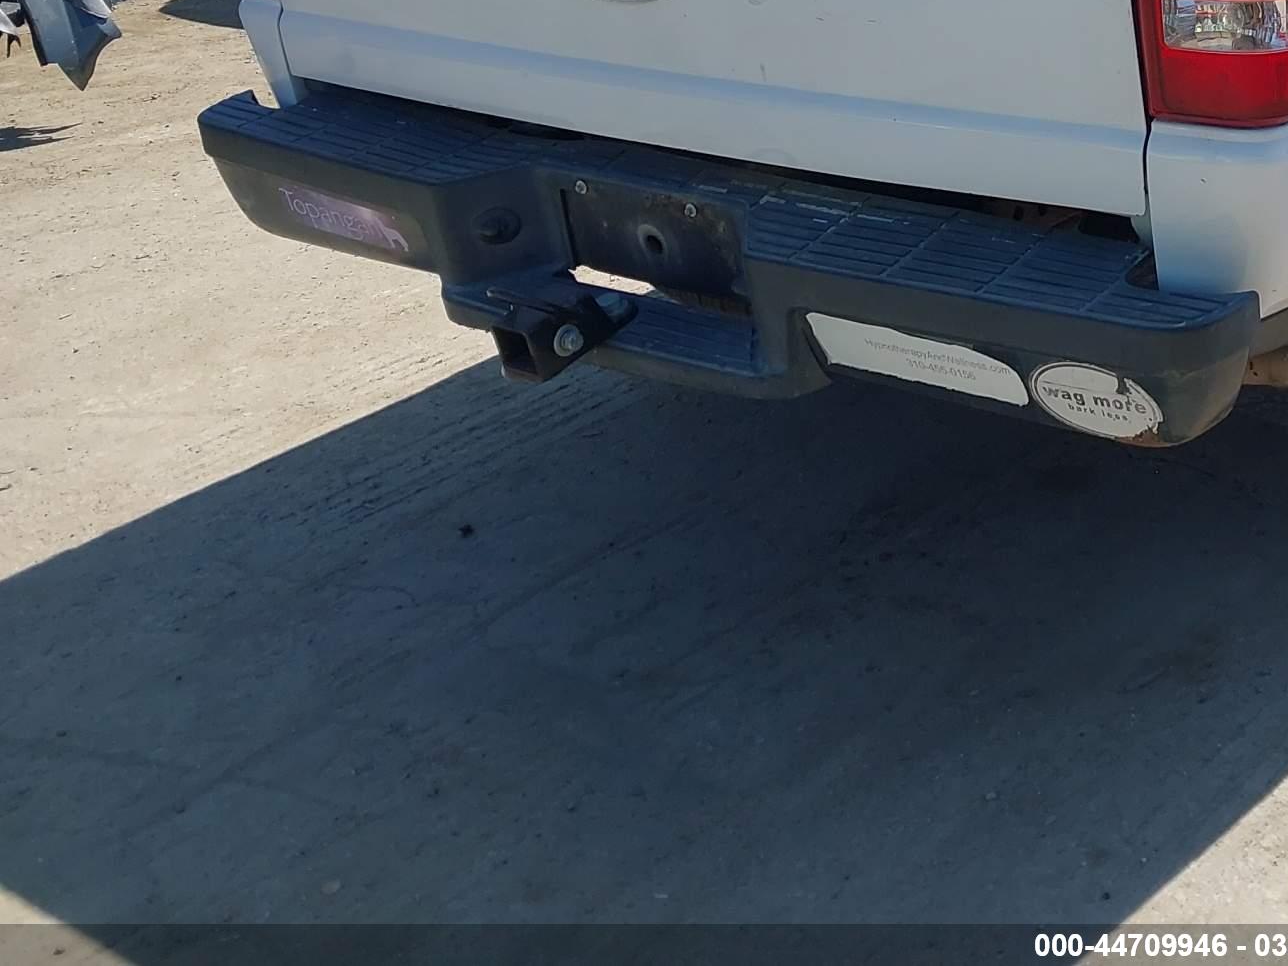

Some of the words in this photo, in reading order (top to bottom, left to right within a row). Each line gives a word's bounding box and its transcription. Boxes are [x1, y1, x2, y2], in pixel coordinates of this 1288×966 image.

[1042, 386, 1086, 406] wag
[1093, 394, 1147, 414] more
[1067, 402, 1096, 415] bark
